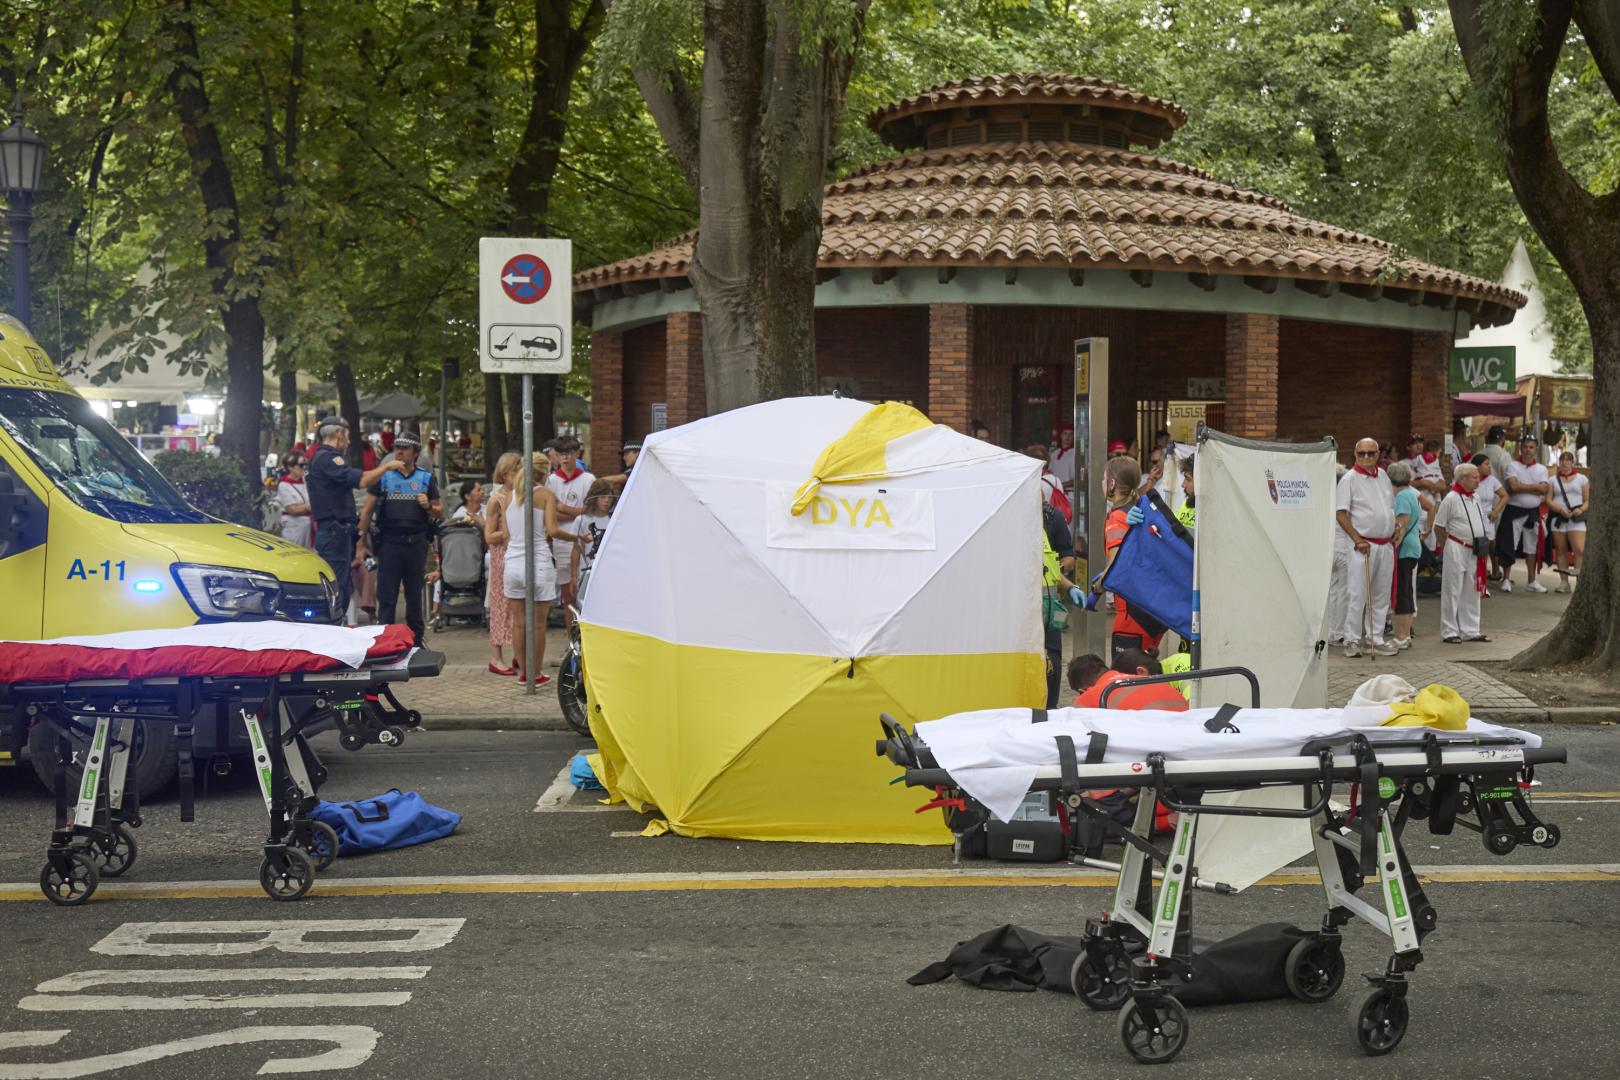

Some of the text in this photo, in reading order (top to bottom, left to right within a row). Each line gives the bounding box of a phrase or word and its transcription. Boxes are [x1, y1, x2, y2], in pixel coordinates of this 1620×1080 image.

[1460, 357, 1502, 382] WC
[811, 496, 894, 528] DYA
[66, 558, 127, 581] A-11
[0, 918, 467, 1080] BUS
